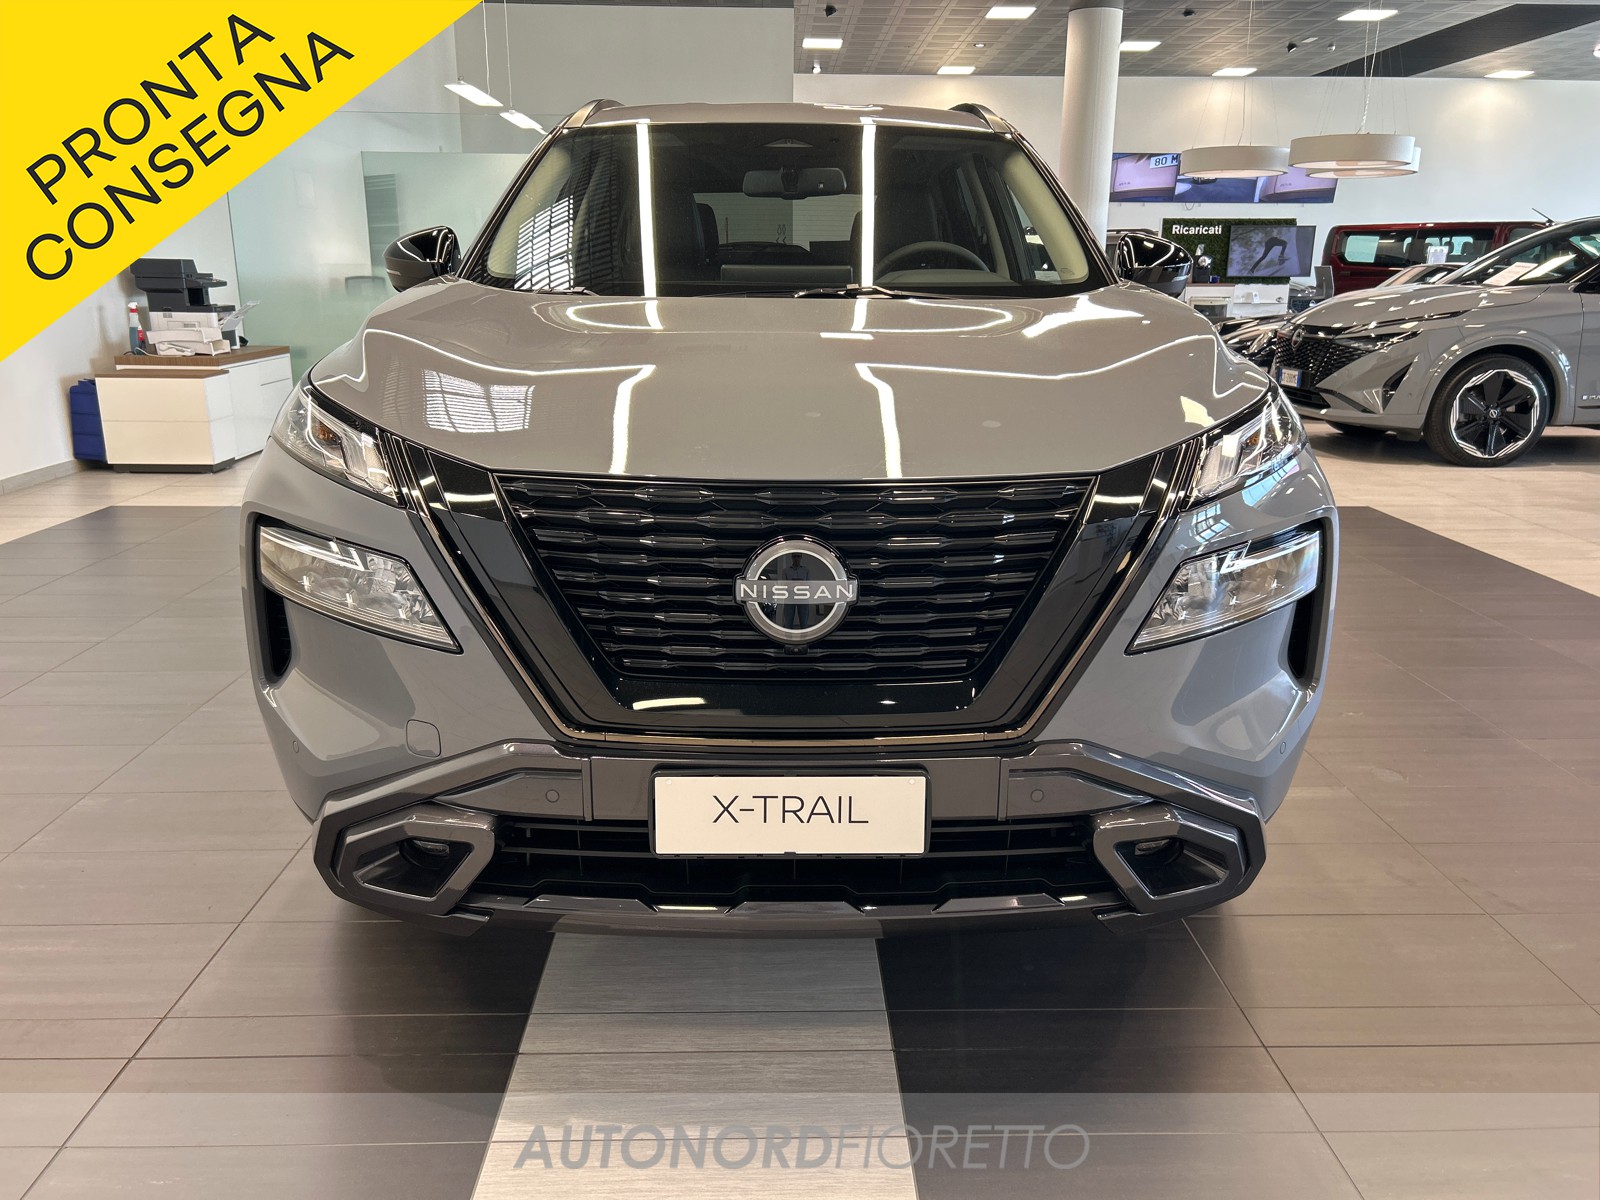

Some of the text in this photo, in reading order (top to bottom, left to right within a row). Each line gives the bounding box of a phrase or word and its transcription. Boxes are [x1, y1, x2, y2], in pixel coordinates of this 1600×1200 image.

[1154, 156, 1168, 166] 80
[1171, 224, 1222, 235] Ricaricati
[740, 583, 853, 599] NISSAN
[712, 795, 869, 824] X-TRAIL
